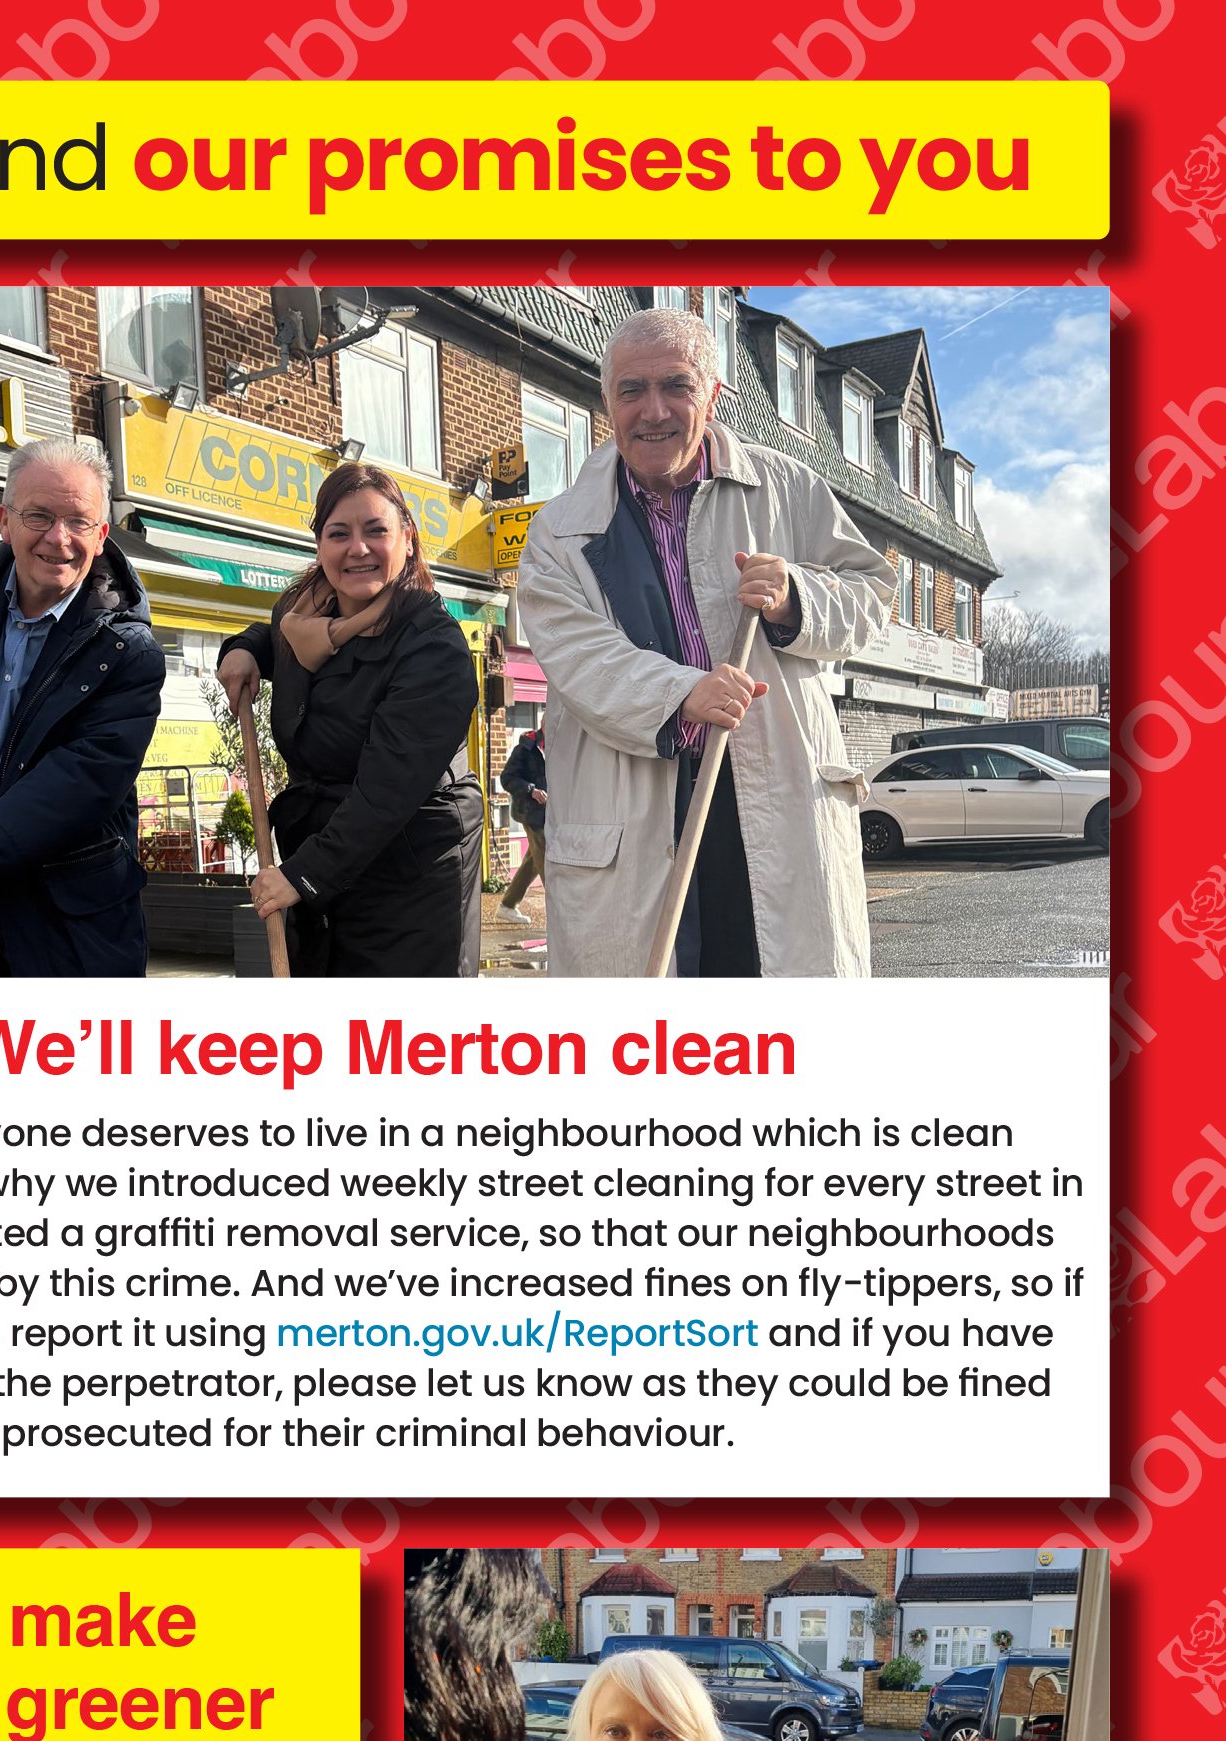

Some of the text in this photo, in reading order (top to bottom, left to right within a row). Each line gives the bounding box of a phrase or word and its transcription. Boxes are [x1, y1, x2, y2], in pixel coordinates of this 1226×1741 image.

[135, 138, 286, 191] our
[310, 117, 730, 214] promises
[751, 127, 841, 191] to
[859, 138, 1028, 214] you
[498, 464, 511, 472] Pay
[499, 469, 517, 478] Point
[131, 474, 147, 488] 128
[165, 482, 243, 510] OFF LICENCE
[1019, 688, 1092, 700] MIXED MARTIAL ARTS GYM
[160, 725, 199, 735] MACHINE
[150, 753, 168, 763] VEG
[161, 1020, 322, 1090] keep
[349, 1020, 585, 1075] Merton
[612, 1020, 794, 1075] clean
[12, 1320, 122, 1356] report
[134, 1317, 155, 1346] it
[166, 1317, 265, 1357] using
[279, 1310, 758, 1357] merton.gov.uk/ReportSort
[769, 1318, 840, 1347] and
[853, 1317, 873, 1346] if
[882, 1325, 949, 1356] you
[963, 1318, 1053, 1347] have
[13, 1592, 195, 1647] make
